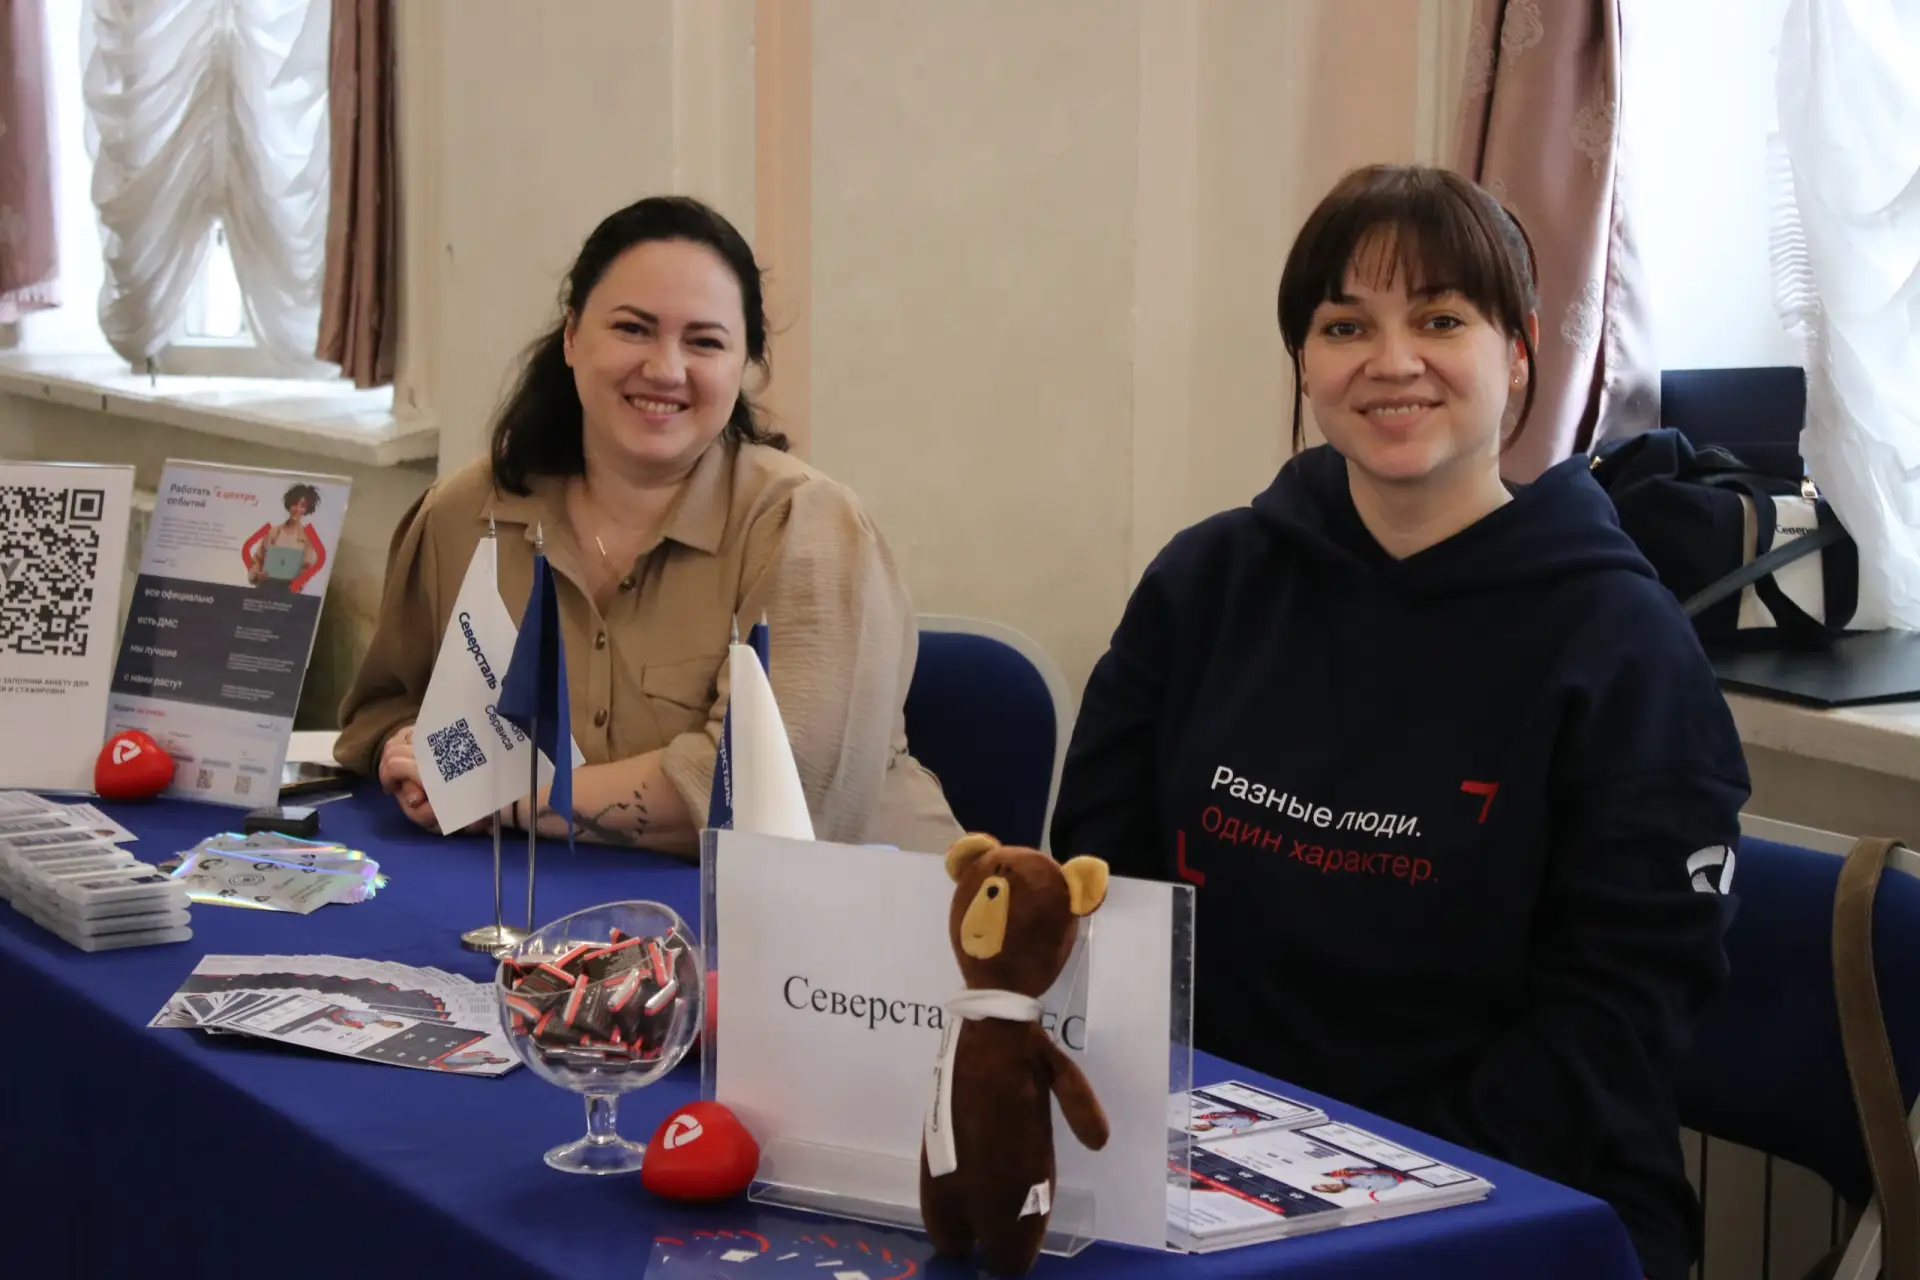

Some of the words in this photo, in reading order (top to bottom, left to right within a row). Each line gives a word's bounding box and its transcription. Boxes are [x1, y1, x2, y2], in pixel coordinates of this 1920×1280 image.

[169, 483, 211, 497] Работать
[161, 589, 215, 604] официально
[157, 616, 179, 628] ДМС
[458, 611, 498, 690] Северсталь
[153, 677, 183, 690] растут
[485, 704, 514, 751] Сервиса
[1210, 765, 1333, 828] Разные
[1336, 810, 1422, 839] люди.
[1202, 805, 1283, 853] Один
[1288, 839, 1438, 886] характер.
[783, 975, 945, 1030] Северста
